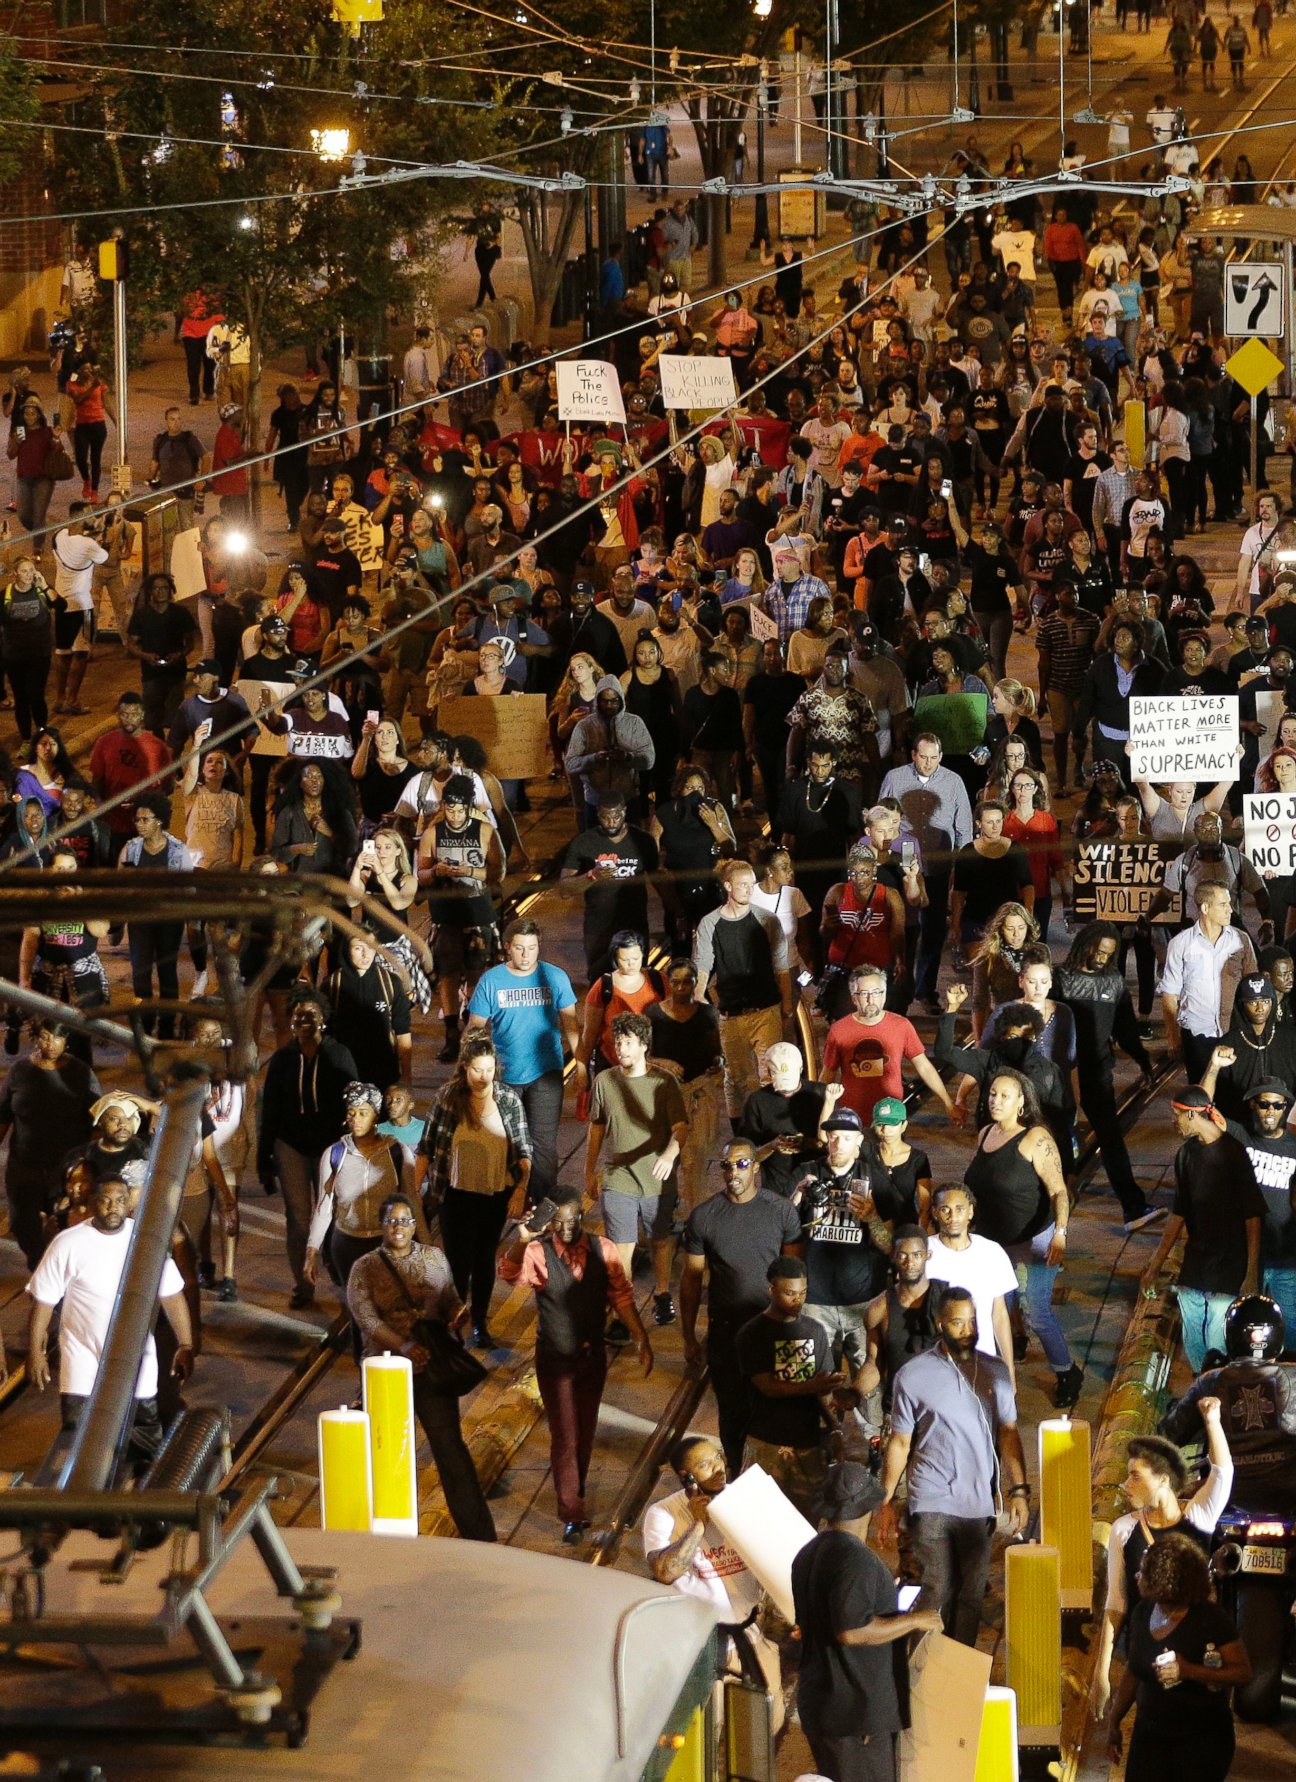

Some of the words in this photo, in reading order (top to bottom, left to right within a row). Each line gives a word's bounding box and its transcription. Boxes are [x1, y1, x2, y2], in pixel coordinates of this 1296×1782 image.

[576, 364, 608, 379] Fuck
[667, 361, 701, 375] STOP
[580, 379, 603, 391] The
[682, 376, 731, 389] KILLING
[572, 391, 609, 407] Police
[664, 387, 701, 401] BLACK
[1182, 697, 1226, 711] LIVES
[1132, 718, 1191, 735] MATTER
[1196, 714, 1231, 727] MORE
[291, 736, 341, 757] PINK
[1133, 738, 1166, 750] THAN
[1175, 734, 1217, 746] WHITE
[1138, 752, 1236, 774] SUPREMACY
[1250, 799, 1280, 820] NO
[440, 839, 480, 848] NIRVANA
[1079, 843, 1160, 861] WHITE
[1252, 846, 1281, 868] NO
[1099, 888, 1181, 914] VIOLEE
[507, 988, 551, 1001] HORNETS
